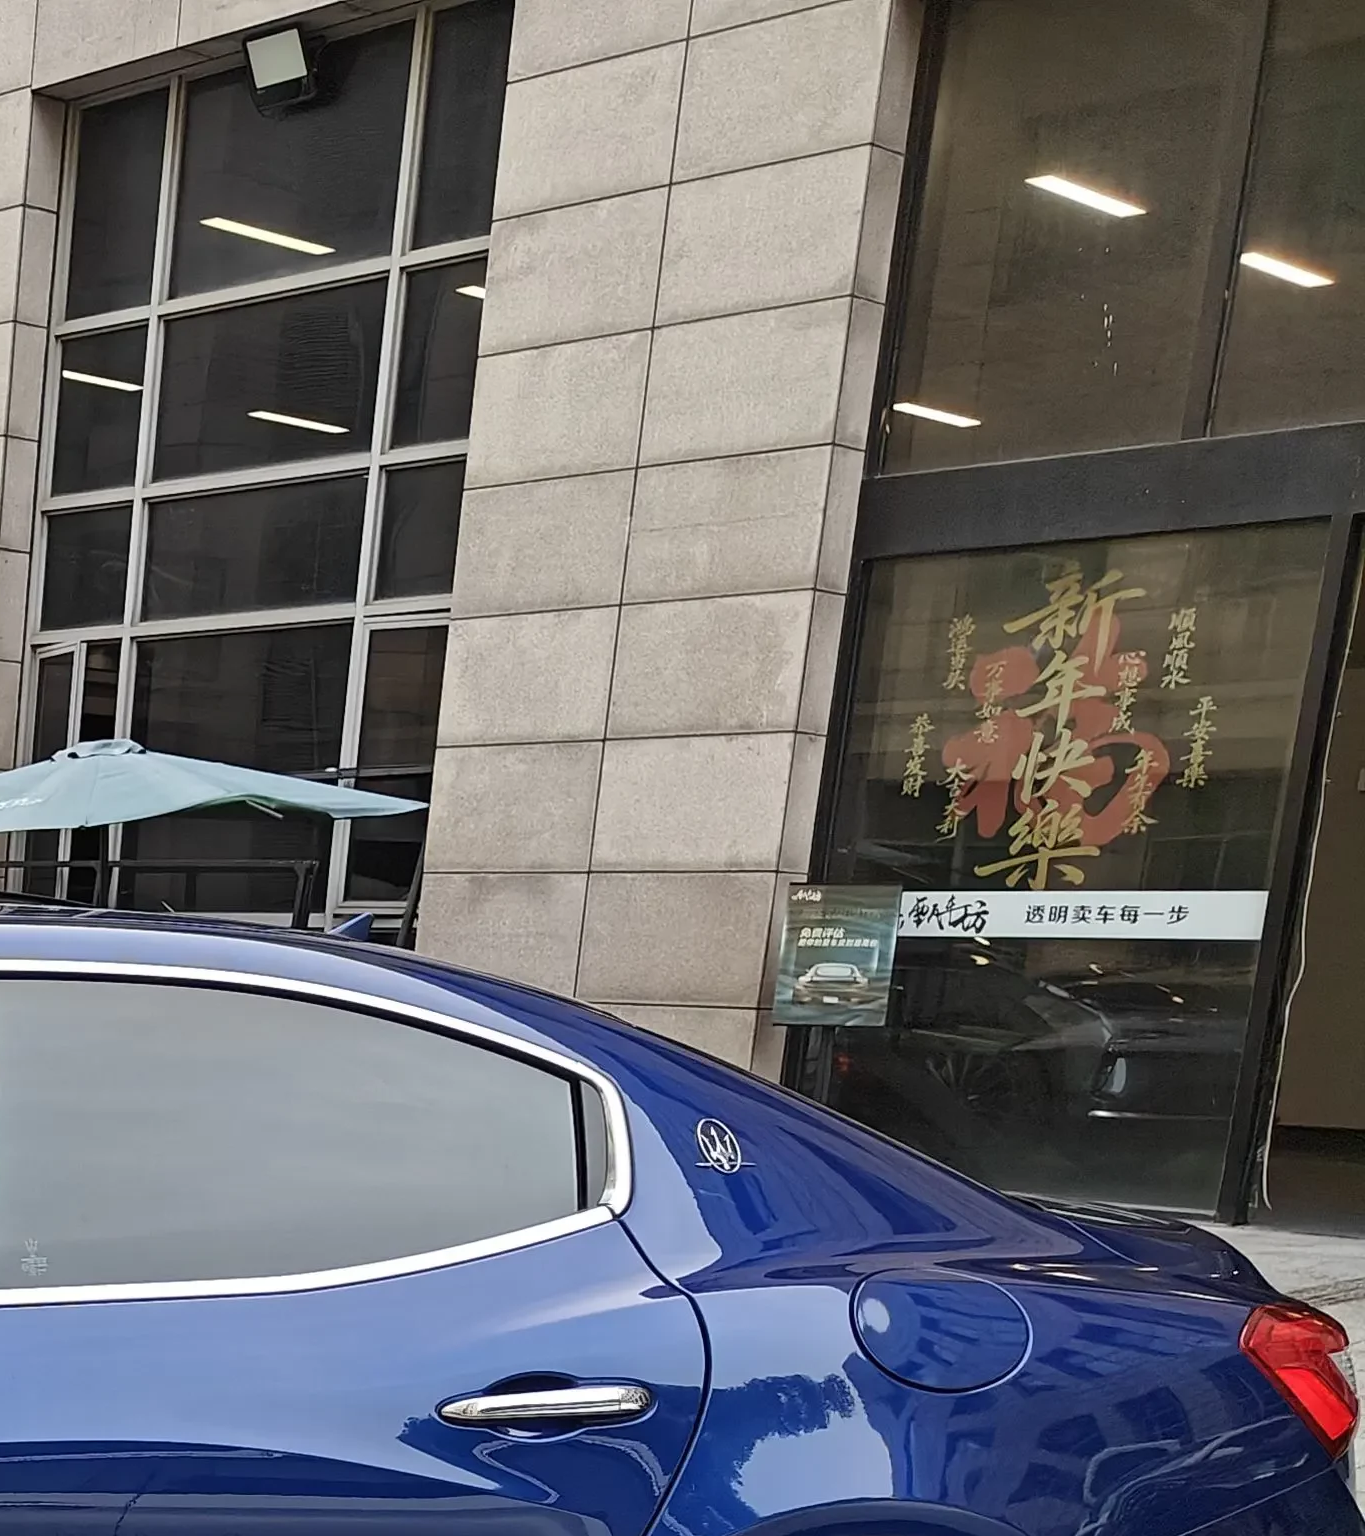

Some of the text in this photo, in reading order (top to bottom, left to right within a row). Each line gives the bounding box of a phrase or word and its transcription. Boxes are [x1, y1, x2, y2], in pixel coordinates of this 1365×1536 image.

[973, 661, 1007, 744] 万事如意
[1108, 650, 1147, 735] 心想事成
[901, 713, 936, 797] 恭喜发财
[935, 757, 973, 843] 大吉大利
[1024, 904, 1190, 926] 透明卖车每一步
